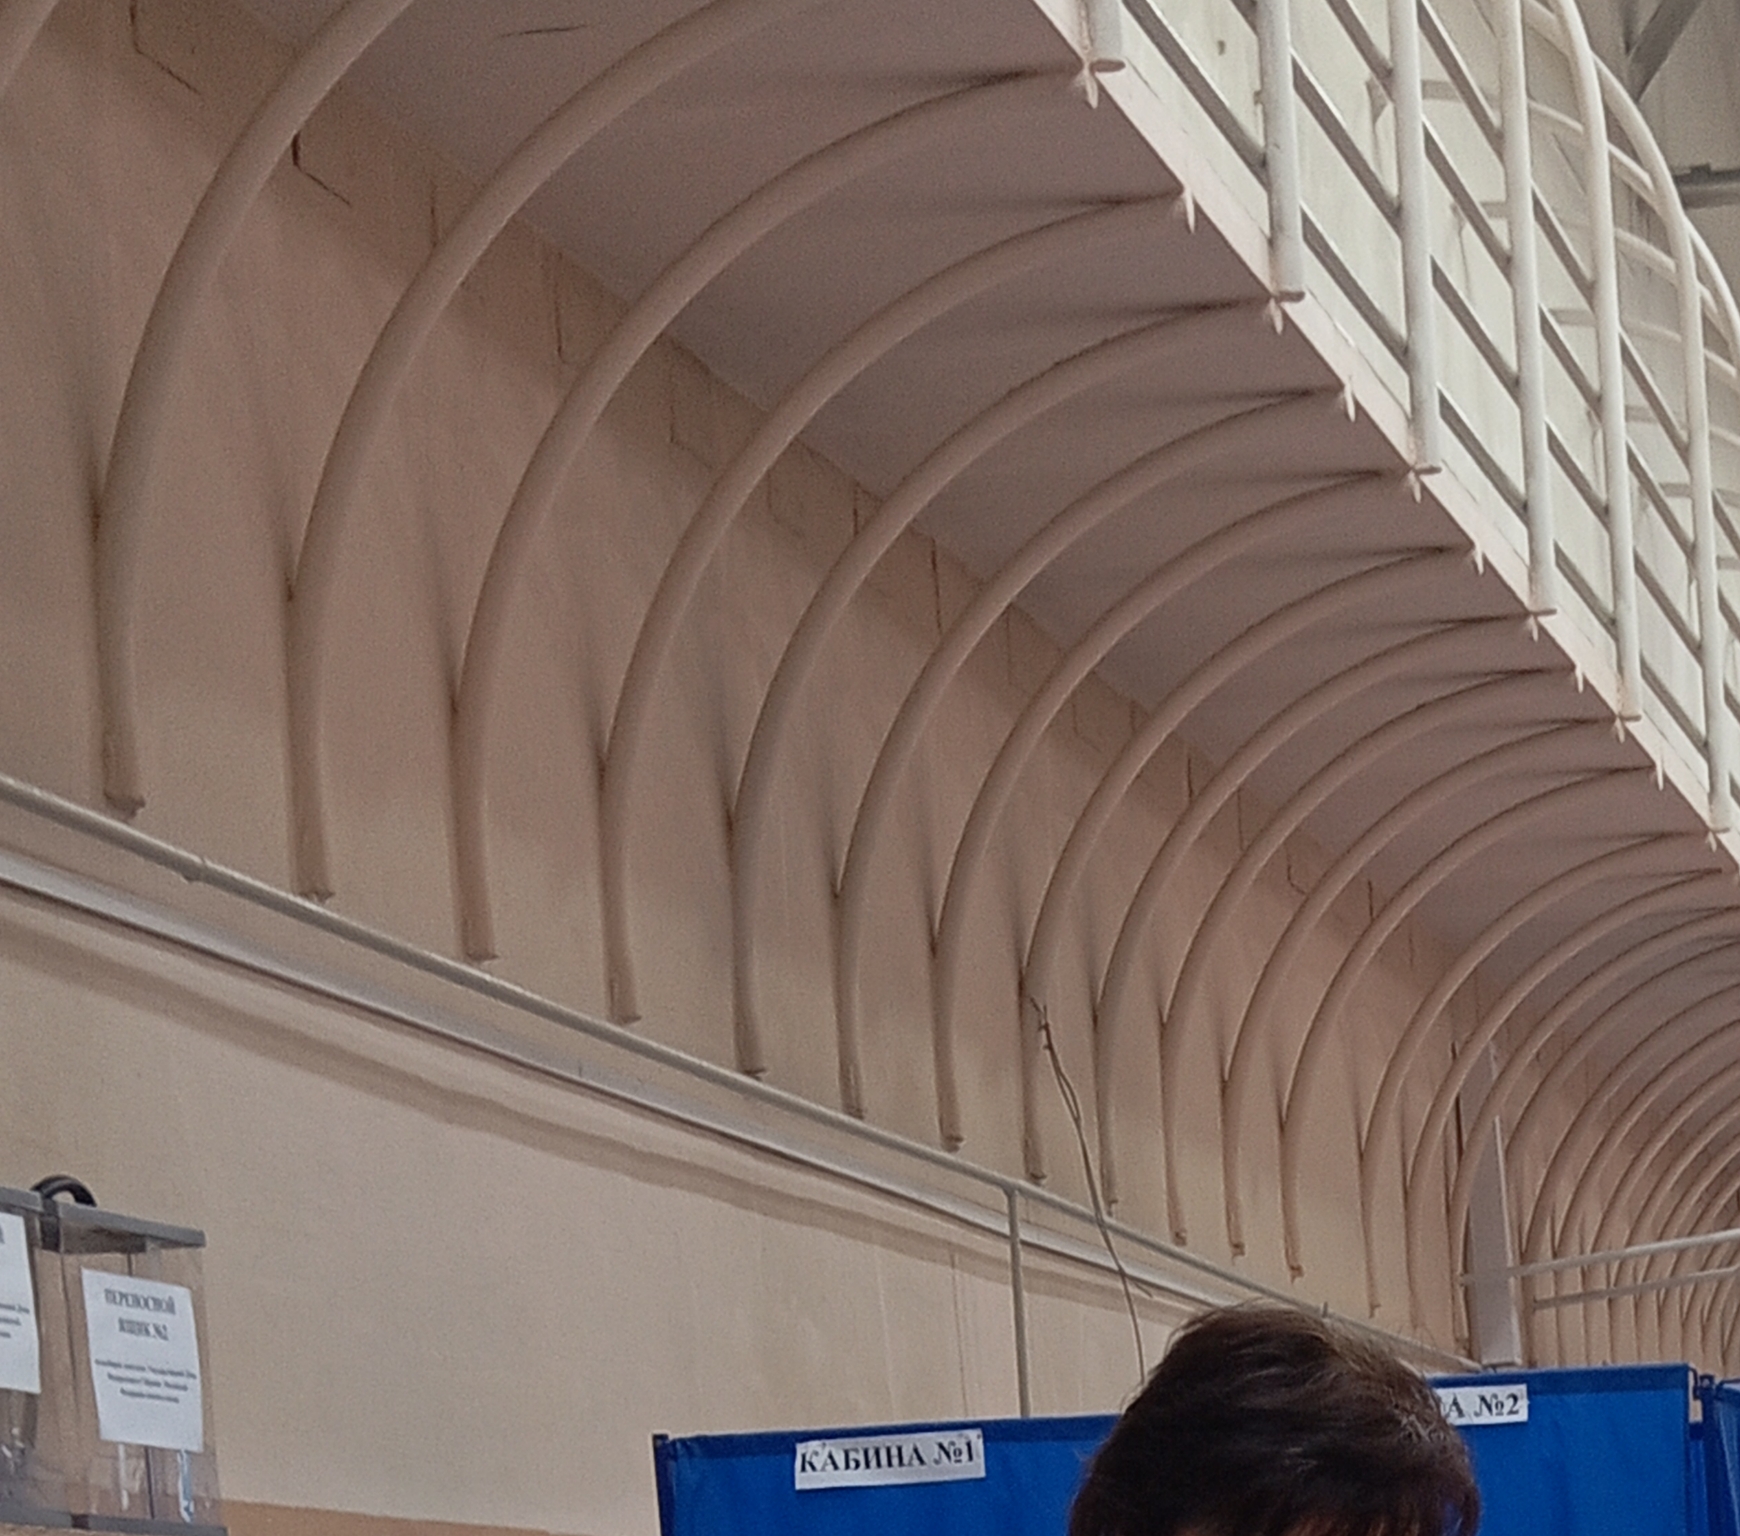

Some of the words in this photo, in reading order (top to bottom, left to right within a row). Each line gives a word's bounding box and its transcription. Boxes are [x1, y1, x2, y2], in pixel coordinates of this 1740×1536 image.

[1473, 1392, 1520, 1417] №2
[799, 1441, 927, 1474] КАБИНА
[932, 1439, 974, 1466] №1
